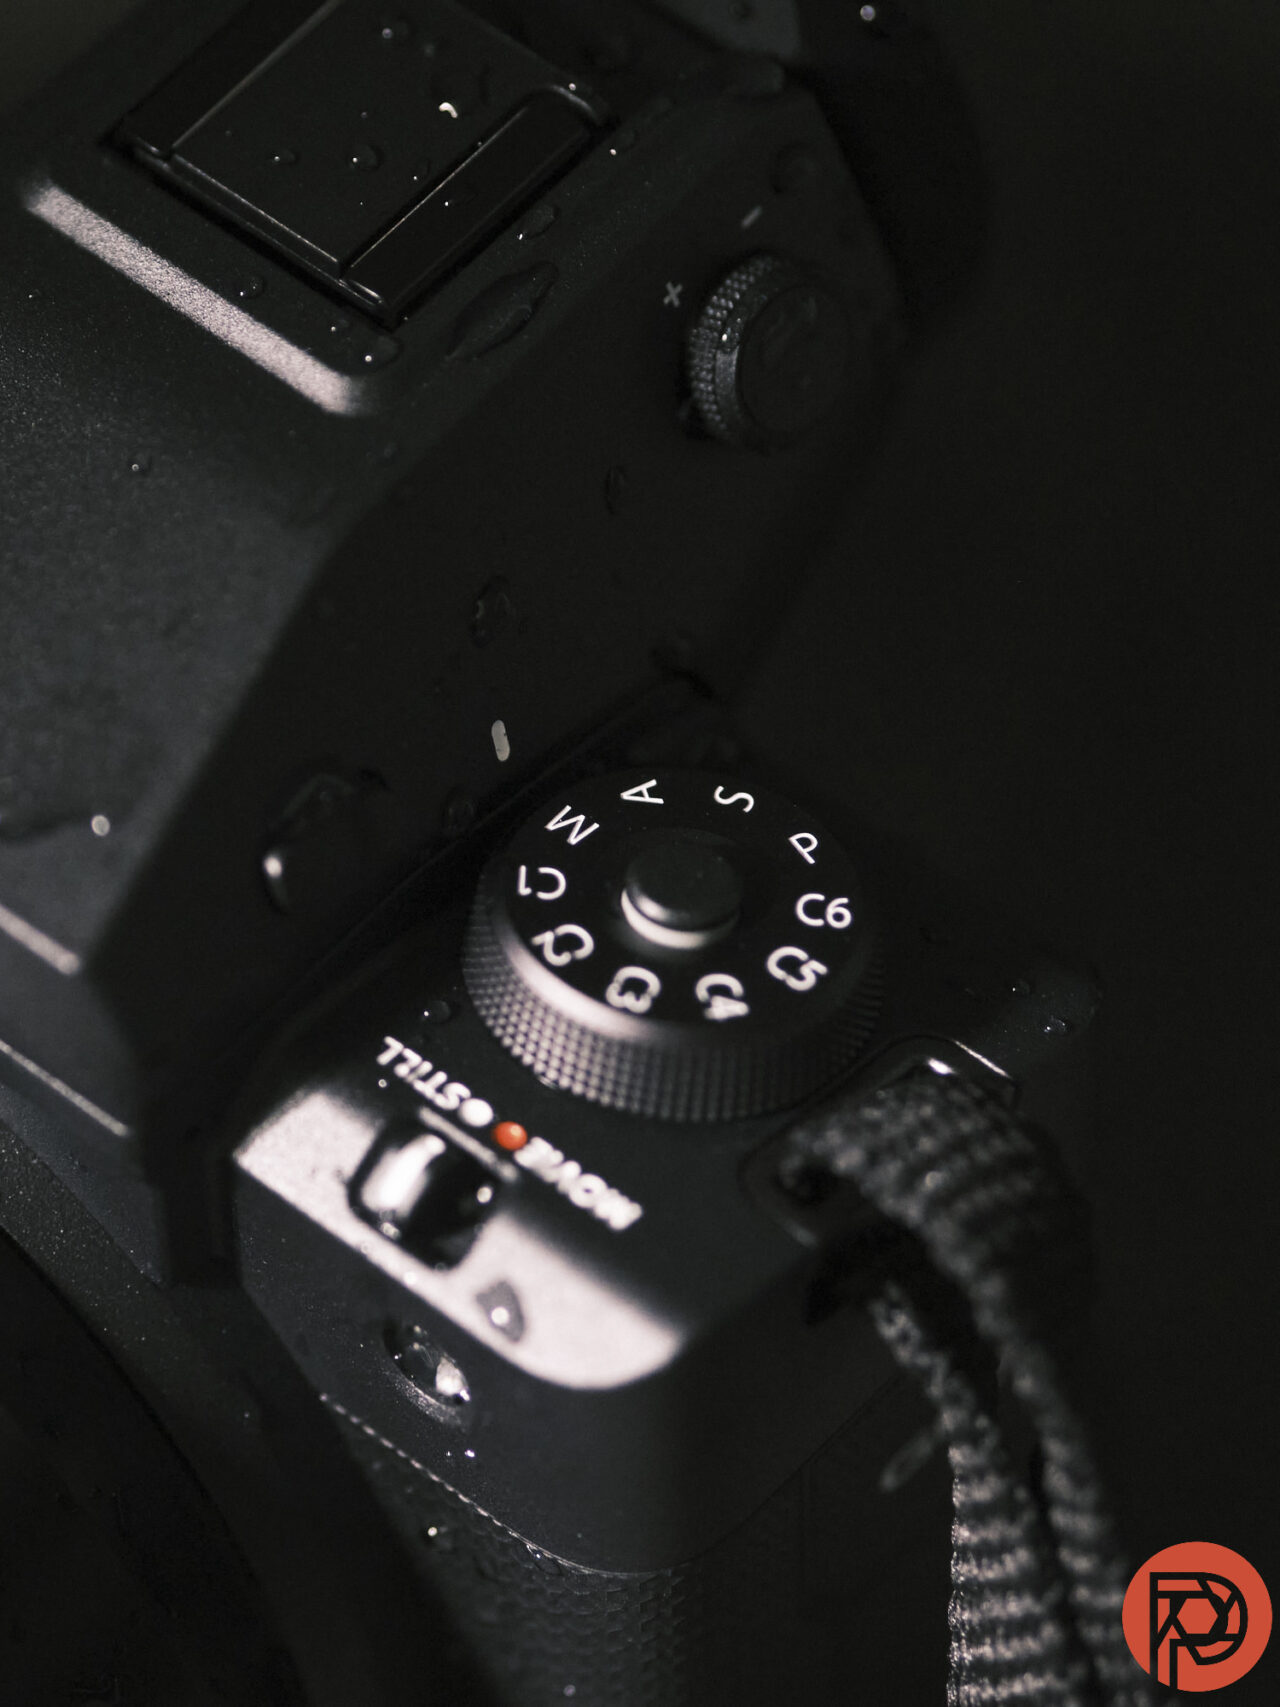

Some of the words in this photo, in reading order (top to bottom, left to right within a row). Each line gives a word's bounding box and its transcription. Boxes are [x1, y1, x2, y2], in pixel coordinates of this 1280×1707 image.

[620, 779, 665, 805] A
[713, 784, 755, 813] S
[544, 804, 600, 846] M
[788, 831, 818, 864] P
[517, 864, 567, 900] C1
[795, 893, 852, 929] C6
[531, 923, 595, 967] C2
[766, 946, 829, 991] C5
[605, 965, 661, 1014] C3
[376, 1035, 472, 1111] STILL
